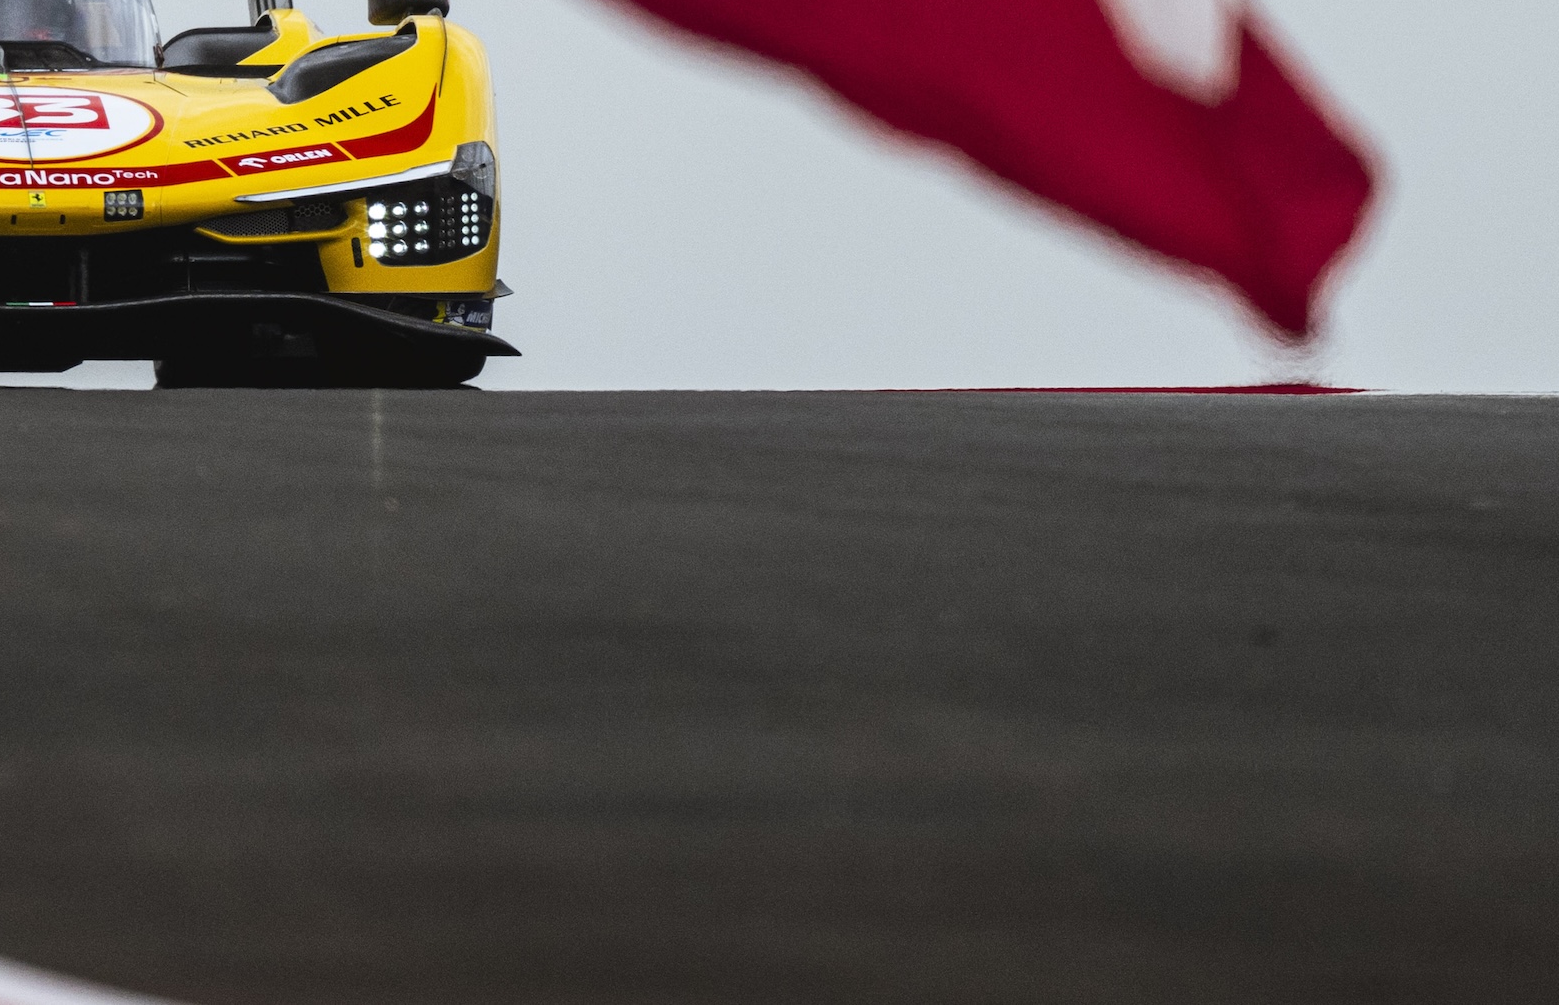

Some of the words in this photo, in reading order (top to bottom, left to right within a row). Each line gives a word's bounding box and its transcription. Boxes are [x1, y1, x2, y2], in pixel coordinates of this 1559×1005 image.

[184, 123, 308, 148] RICHARD
[313, 94, 401, 127] MILLE
[270, 148, 332, 164] ORLEN
